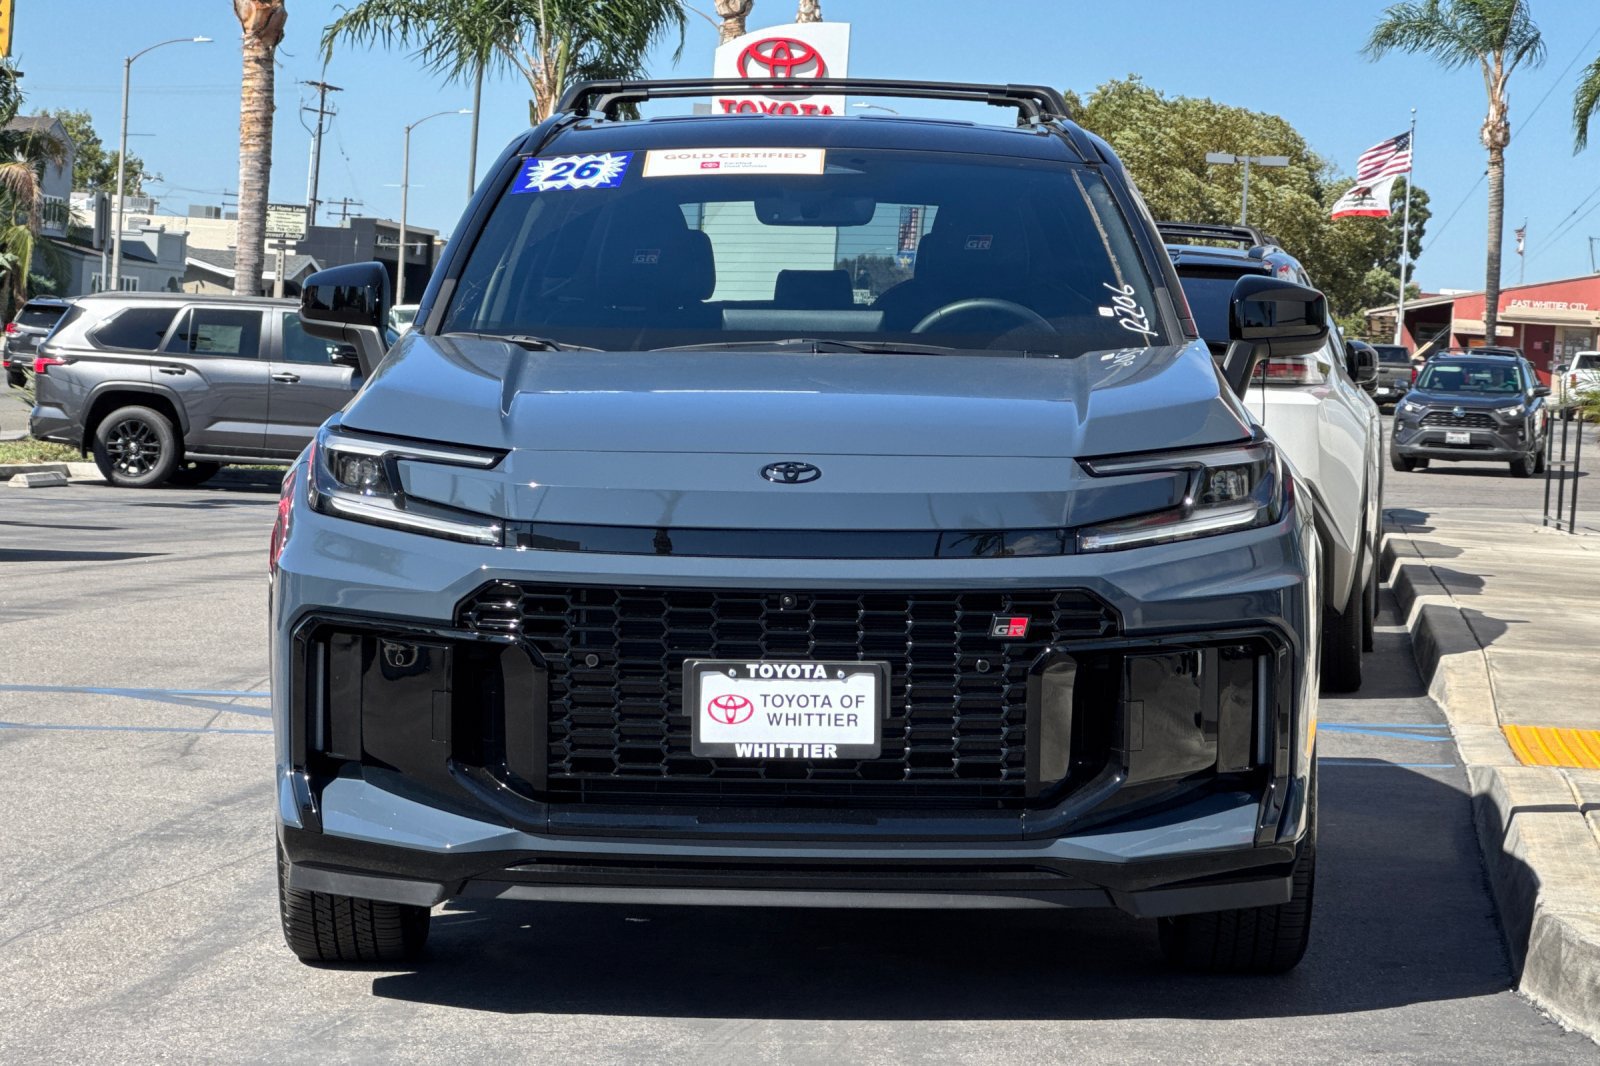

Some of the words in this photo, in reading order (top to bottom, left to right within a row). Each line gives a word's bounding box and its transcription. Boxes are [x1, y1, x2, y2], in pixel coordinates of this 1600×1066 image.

[718, 99, 834, 115] TOYOTA
[542, 161, 605, 182] 26
[1511, 299, 1531, 308] EAST
[1532, 301, 1568, 309] WHITTIER
[1569, 303, 1588, 311] CITY
[994, 624, 1026, 636] GR
[746, 664, 827, 679] TOYOTA
[760, 694, 832, 708] TOYOTA
[840, 694, 866, 708] OF
[766, 713, 858, 727] WHITTIER
[735, 743, 838, 758] WHITTIER
